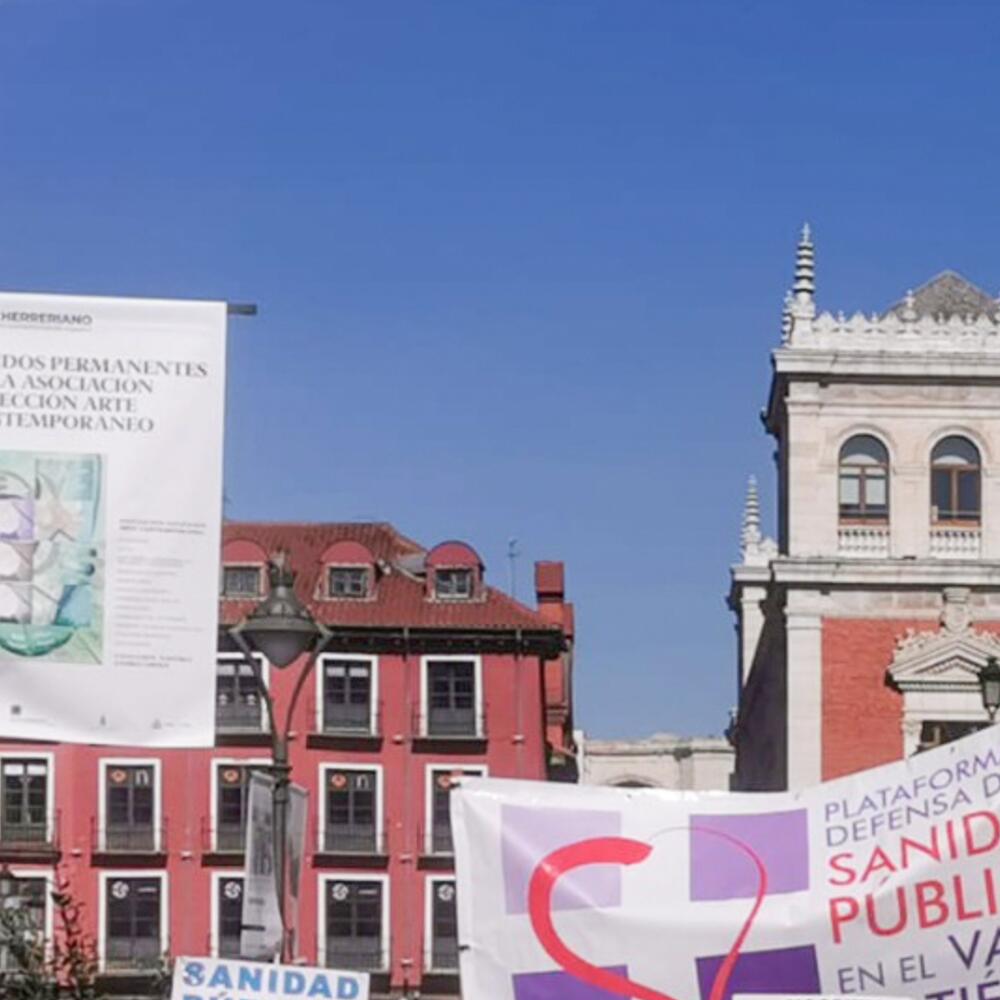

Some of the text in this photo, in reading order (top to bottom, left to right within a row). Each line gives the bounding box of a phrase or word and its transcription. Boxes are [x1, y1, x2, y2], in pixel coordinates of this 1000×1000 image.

[50, 356, 209, 378] PERMANENTES
[83, 396, 138, 413] ARTE
[826, 788, 972, 847] DEFENSA
[183, 961, 360, 1000] SANIDAD
[838, 962, 885, 994] EN
[900, 954, 936, 985] EL
